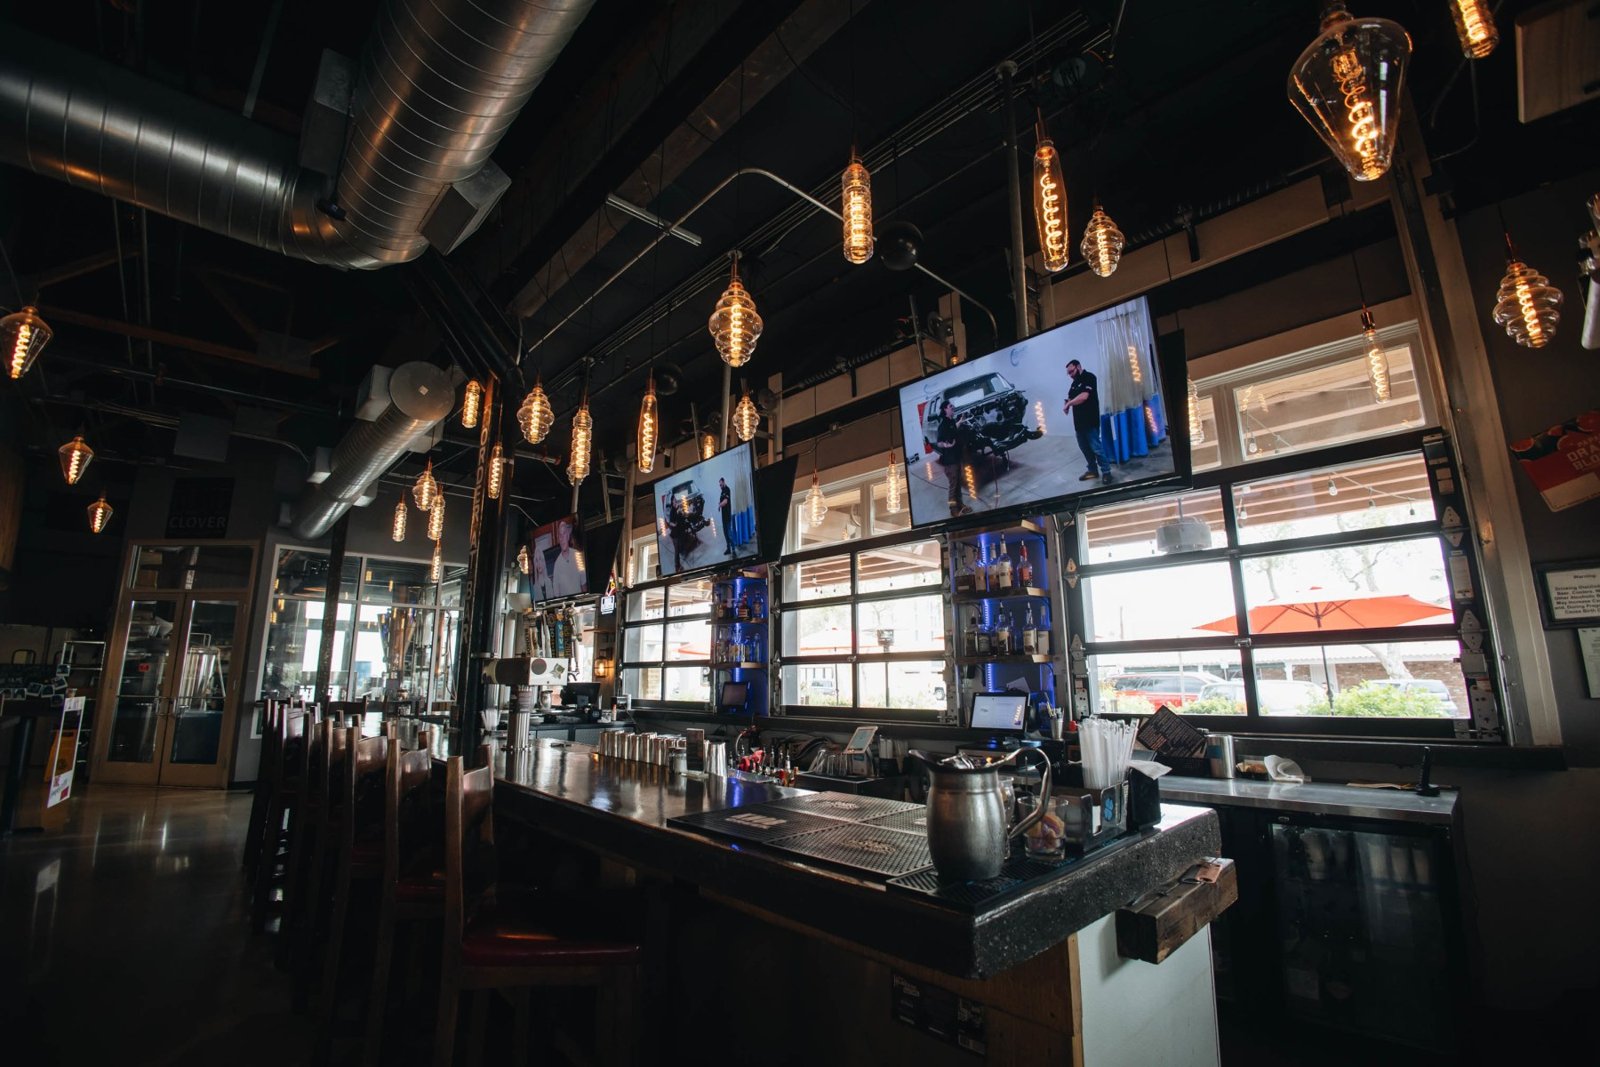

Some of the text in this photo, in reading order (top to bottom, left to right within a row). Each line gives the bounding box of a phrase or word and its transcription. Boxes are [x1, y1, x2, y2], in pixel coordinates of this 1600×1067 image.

[473, 427, 489, 523] ORDER
[168, 516, 227, 528] CLOVER
[461, 580, 473, 644] BAR
